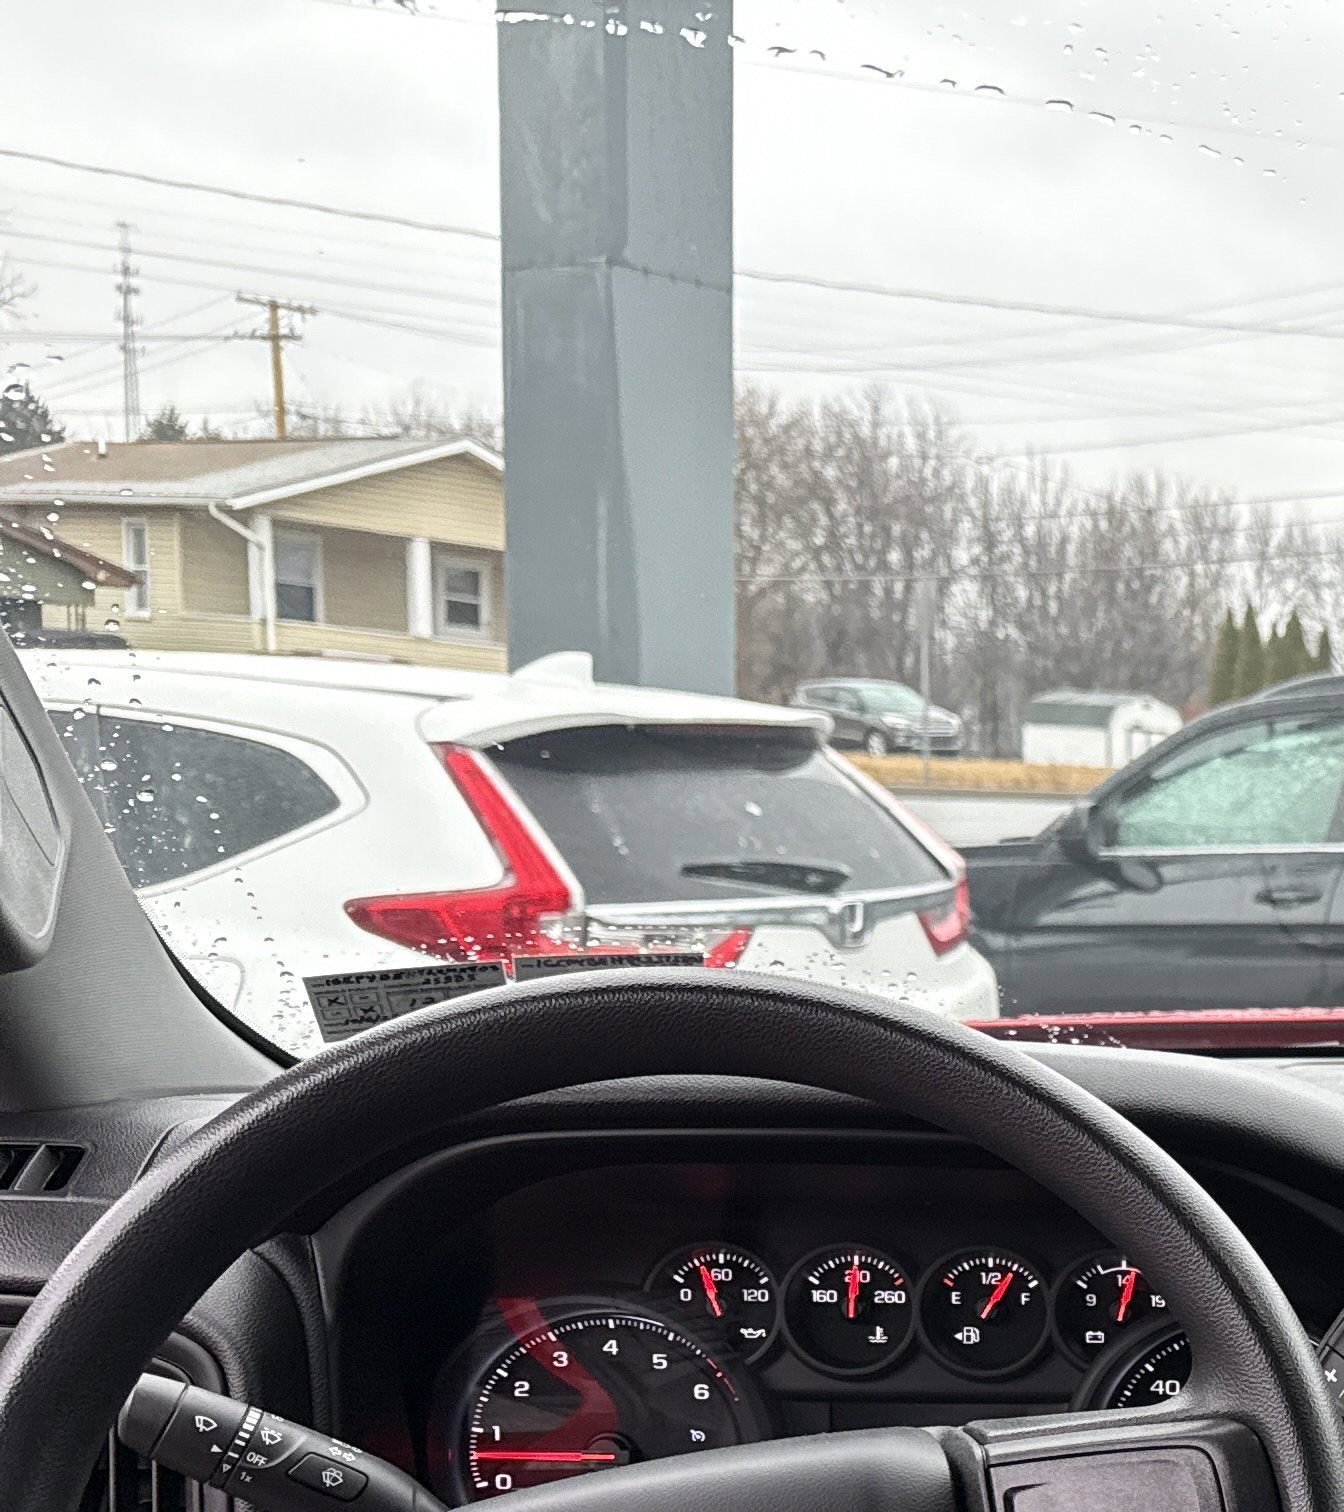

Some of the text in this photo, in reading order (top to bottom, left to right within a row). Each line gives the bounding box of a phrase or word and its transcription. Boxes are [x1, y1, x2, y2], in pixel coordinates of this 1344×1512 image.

[710, 1268, 733, 1282] 60
[844, 1270, 871, 1284] 20
[979, 1272, 1002, 1285] 1/2
[679, 1288, 692, 1302] 0
[742, 1288, 769, 1302] 120
[810, 1289, 838, 1303] 160
[873, 1290, 906, 1304] 260
[951, 1291, 962, 1305] E
[1020, 1292, 1031, 1306] F
[1085, 1293, 1097, 1307] 9
[602, 1339, 619, 1356] 4
[552, 1351, 569, 1368] 3
[652, 1353, 668, 1370] 5
[513, 1381, 530, 1397] 2
[693, 1383, 710, 1400] 6
[1149, 1379, 1181, 1396] 40
[491, 1425, 501, 1441] 1
[246, 1451, 269, 1467] OFF
[494, 1473, 512, 1490] 0
